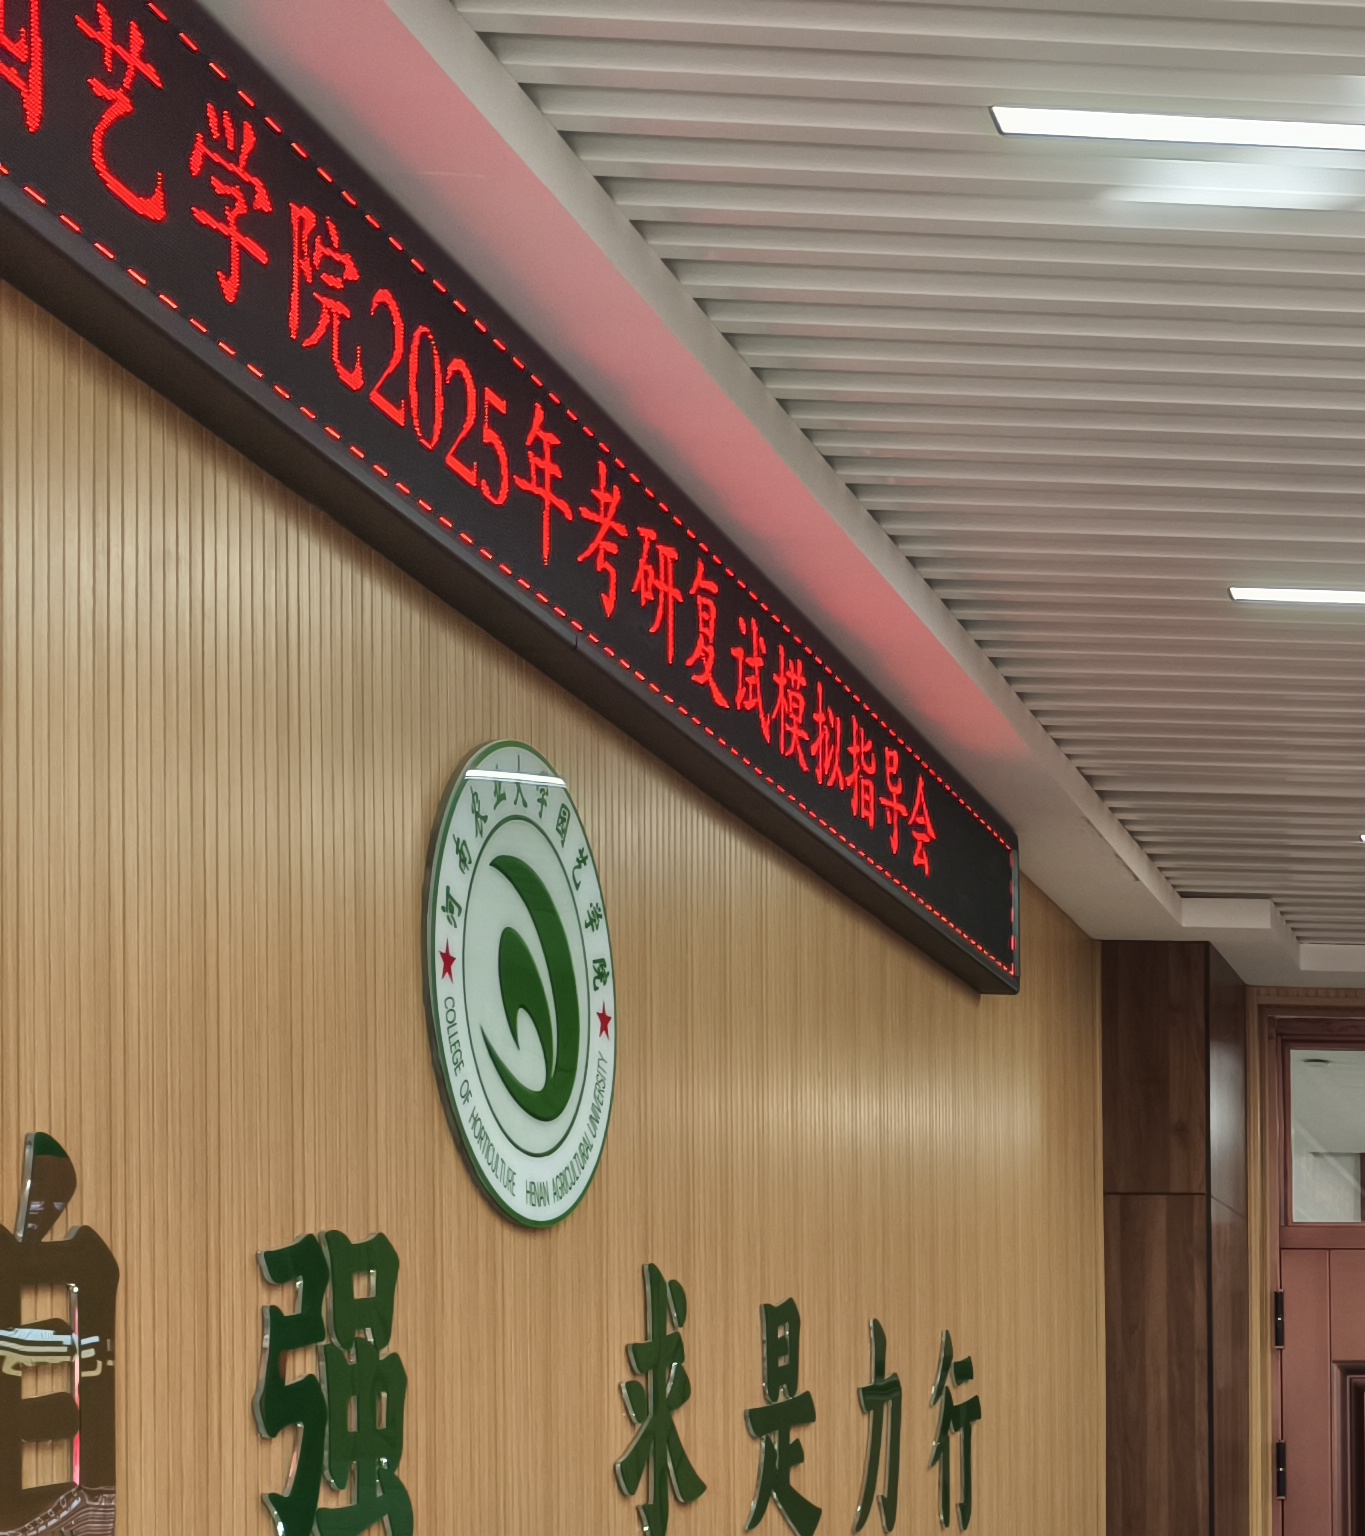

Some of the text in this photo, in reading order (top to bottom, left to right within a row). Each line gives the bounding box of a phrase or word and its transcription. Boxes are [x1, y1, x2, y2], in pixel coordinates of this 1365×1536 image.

[444, 996, 517, 1197] COLLEGE OF HORTICULTURE
[525, 1050, 608, 1207] HENAN AGRICULTURAL UNIVERSITY
